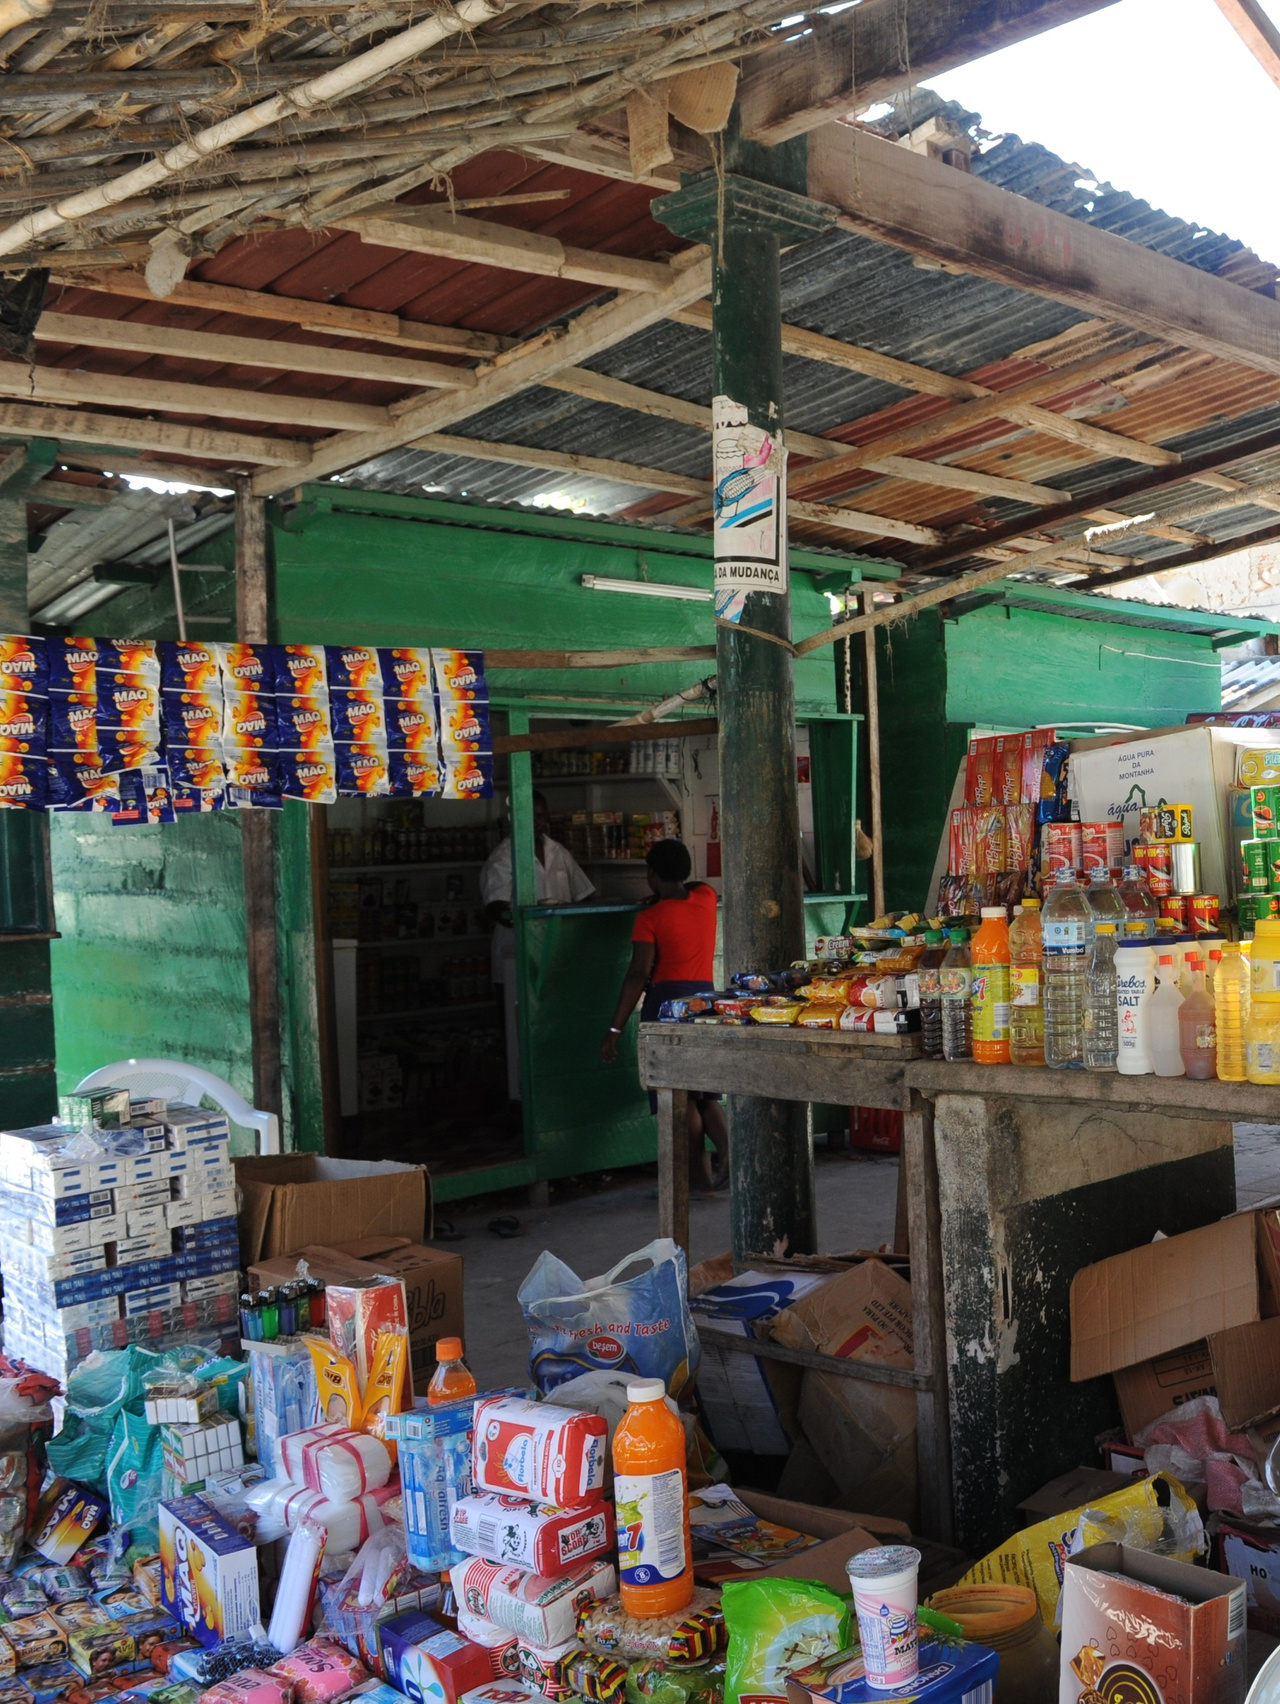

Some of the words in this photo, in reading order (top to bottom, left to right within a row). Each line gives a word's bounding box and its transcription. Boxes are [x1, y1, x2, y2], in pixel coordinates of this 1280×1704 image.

[729, 566, 780, 584] MUDANÇA
[66, 651, 99, 664] MAQ
[178, 651, 210, 664] MAQ
[288, 657, 317, 671] MAQ
[342, 652, 370, 664] MAQ
[1, 660, 36, 673] MAQ
[234, 664, 262, 678] MAQ
[114, 689, 148, 703] MAQ
[182, 708, 213, 722] MAQ
[347, 703, 375, 718] MAQ
[293, 711, 321, 725] MAQ
[0, 722, 34, 736] MAQ
[236, 720, 266, 733] MAQ
[1118, 751, 1135, 763] ÁGUA
[1137, 750, 1154, 760] PURA
[239, 771, 269, 785] MAQ
[297, 764, 327, 779] MAQ
[1119, 768, 1154, 780] MONTANHA
[1108, 801, 1139, 820] água
[1118, 996, 1140, 1007] SALT
[608, 1322, 631, 1335] and
[634, 1318, 670, 1337] Taste
[592, 1340, 617, 1352] beşem
[36, 1488, 78, 1546] MAQ
[81, 1504, 98, 1530] MAQ
[567, 1529, 581, 1543] TOP
[561, 1536, 587, 1556] SCORE
[174, 1525, 196, 1628] MAQ
